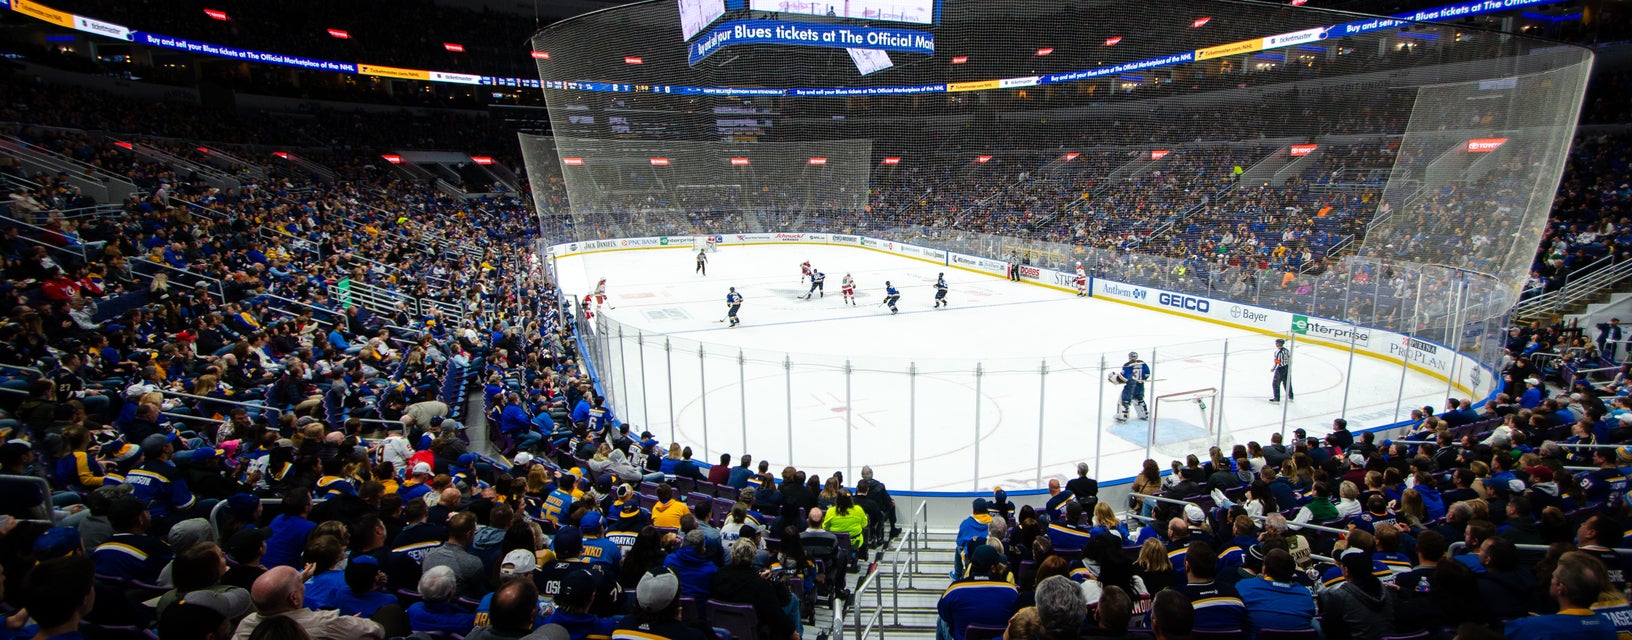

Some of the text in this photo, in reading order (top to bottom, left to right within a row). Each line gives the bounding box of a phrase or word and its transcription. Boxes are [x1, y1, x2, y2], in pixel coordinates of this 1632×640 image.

[1346, 24, 1361, 33] Buy
[1362, 20, 1377, 29] and
[1379, 18, 1392, 28] sell
[1416, 11, 1438, 21] Blues
[1441, 6, 1469, 17] tickets
[1484, 1, 1501, 10] The
[734, 24, 772, 39] Blues
[776, 26, 818, 41] tickets
[822, 30, 836, 42] at
[839, 30, 863, 44] The
[867, 32, 912, 47] Official
[1280, 33, 1312, 43] ticketmaster
[147, 35, 160, 45] Buy
[162, 39, 174, 47] and
[176, 40, 187, 48] sell
[203, 44, 218, 54] Blues
[219, 48, 238, 57] tickets
[248, 52, 259, 60] The
[261, 53, 282, 62] Official
[284, 57, 319, 67] Marketplace
[328, 62, 339, 70] the
[1139, 59, 1165, 68] Marketplace
[1020, 266, 1040, 276] DOBBS
[1102, 284, 1131, 297] Anthem
[1159, 293, 1210, 313] GEICO
[1243, 309, 1268, 322] Bayer
[1296, 317, 1368, 341] enterprise
[1412, 340, 1436, 354] PURINA
[1390, 342, 1447, 370] PRO PLAN
[1132, 368, 1142, 380] 31
[60, 384, 71, 392] 27
[1580, 478, 1593, 490] 91
